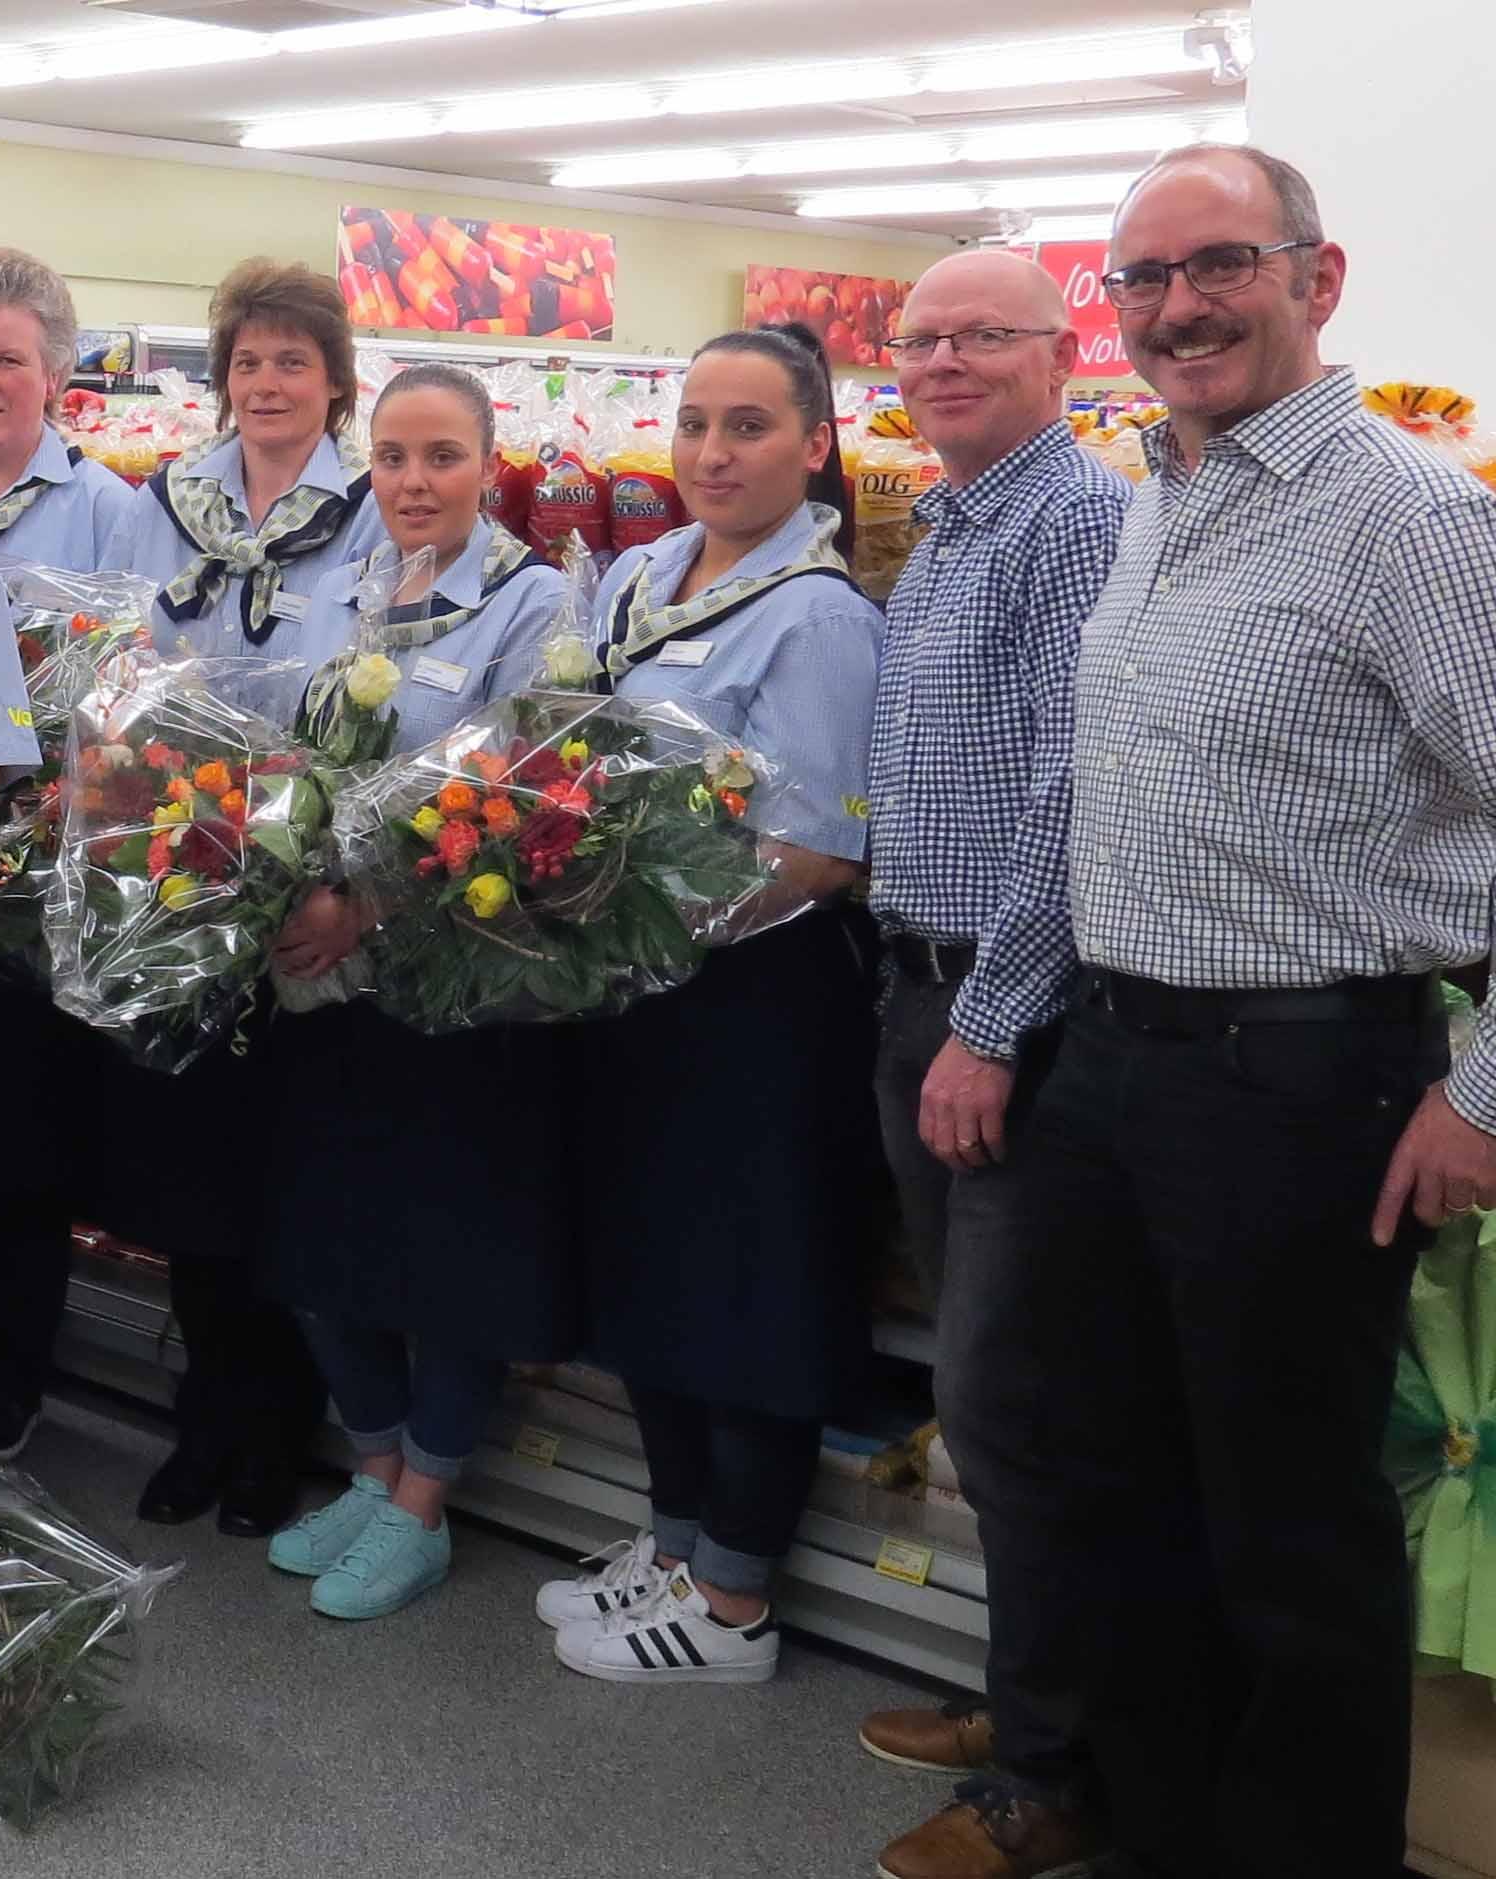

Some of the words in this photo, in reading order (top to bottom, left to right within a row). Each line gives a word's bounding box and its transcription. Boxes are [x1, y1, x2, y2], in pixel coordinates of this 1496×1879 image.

[860, 473, 910, 494] OLG
[8, 706, 32, 727] Vo
[840, 795, 868, 818] Vo
